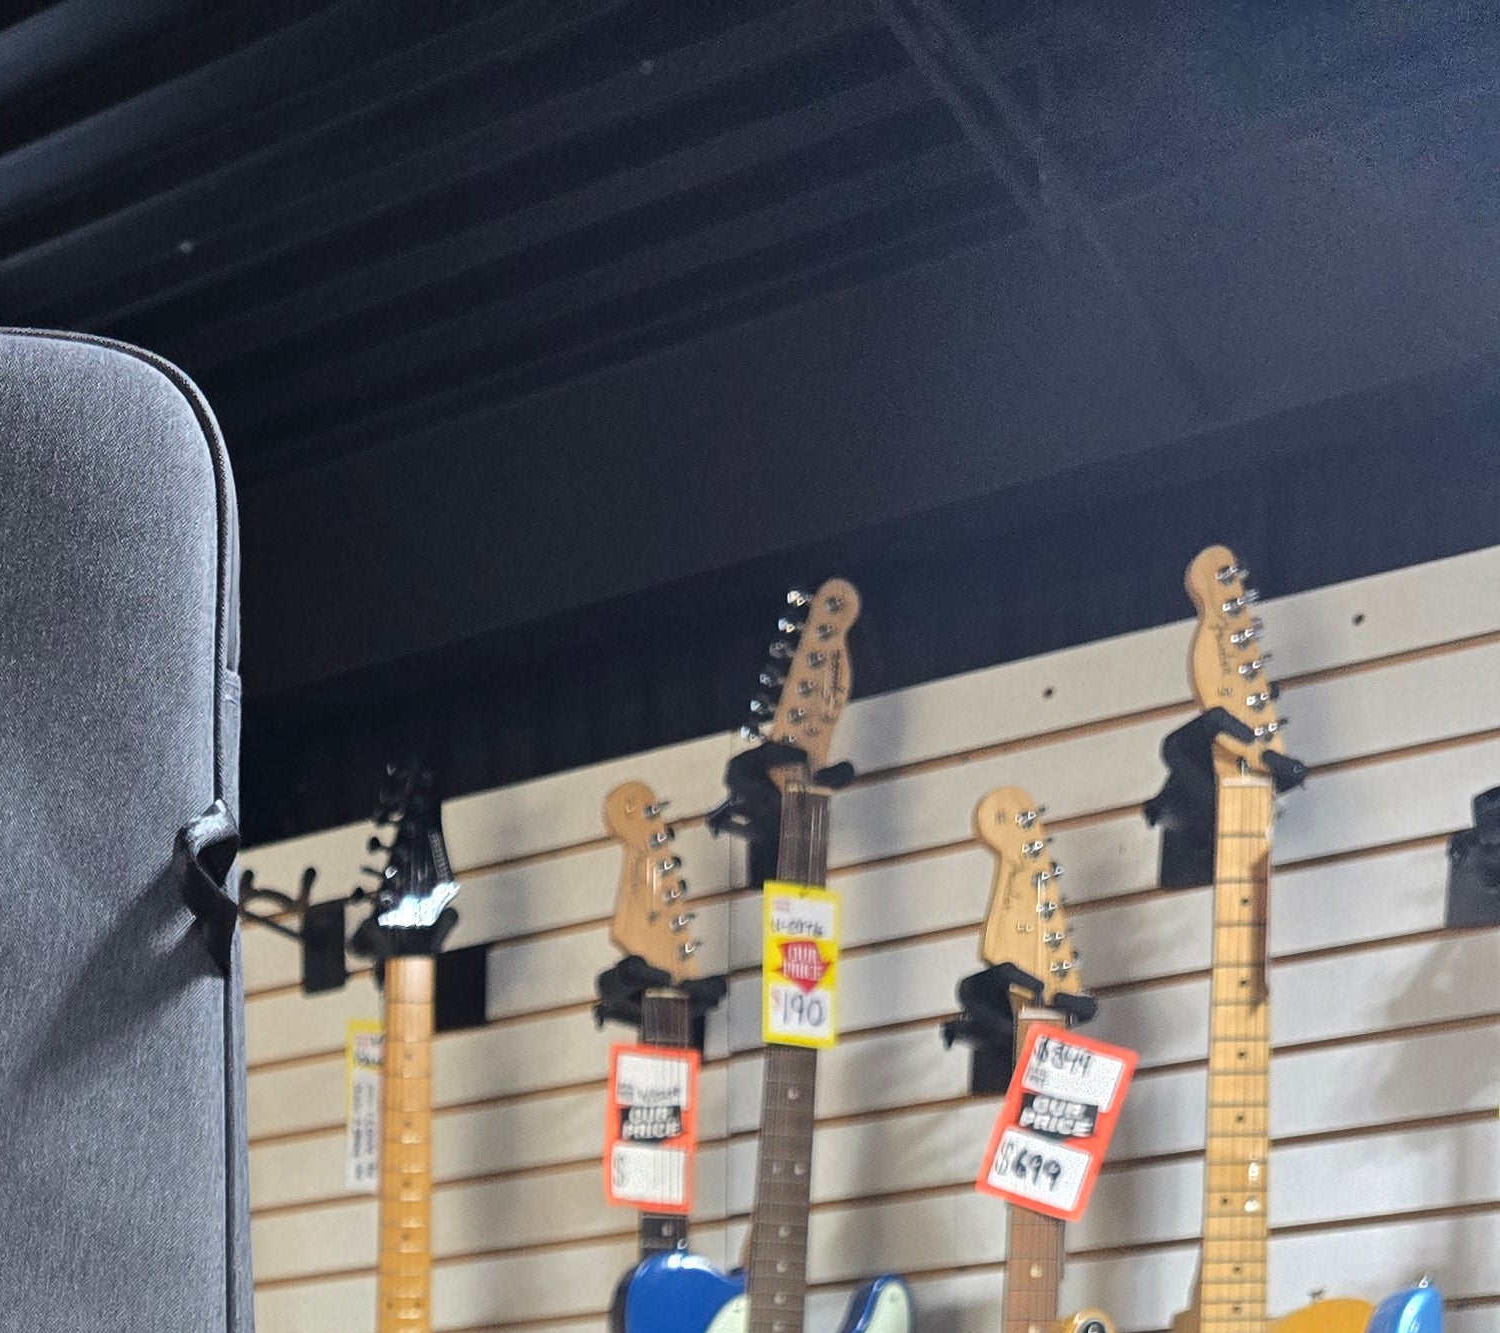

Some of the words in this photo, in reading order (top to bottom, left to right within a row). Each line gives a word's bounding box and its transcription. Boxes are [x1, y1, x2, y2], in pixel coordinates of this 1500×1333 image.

[628, 1106, 675, 1125] OUR
[1031, 1093, 1087, 1120] OUR
[621, 1120, 682, 1141] PRICE
[1018, 1106, 1095, 1138] PRICE
